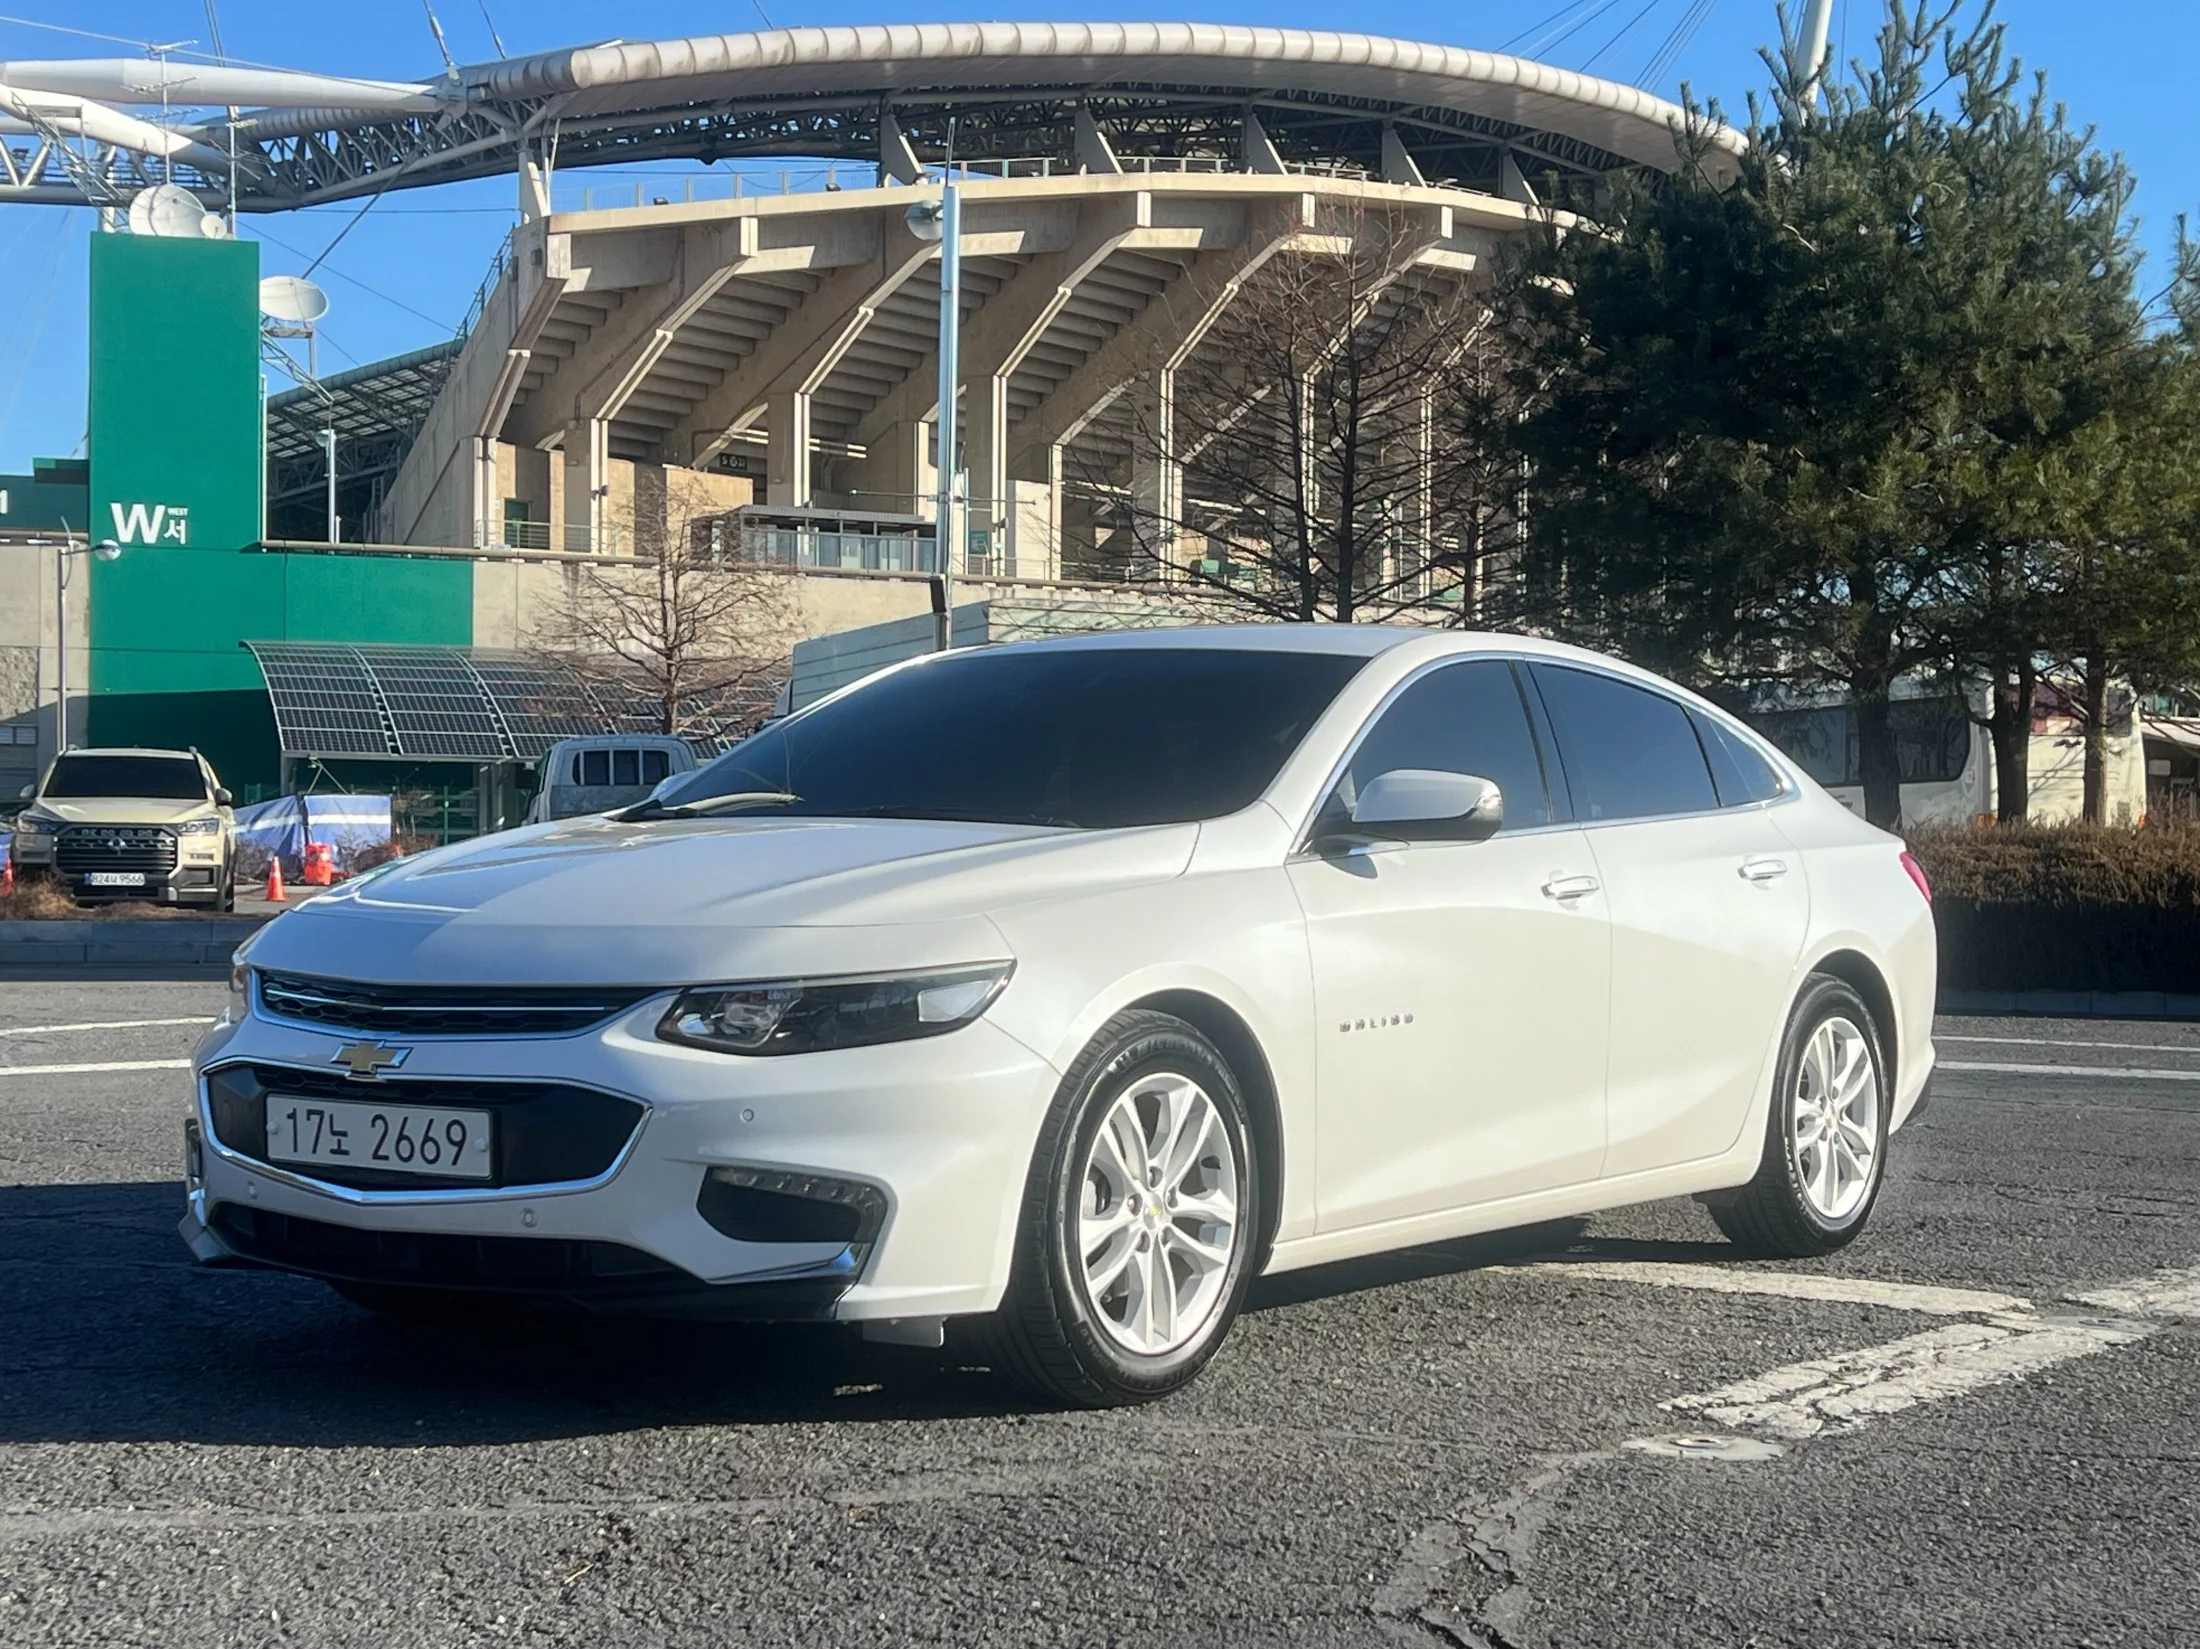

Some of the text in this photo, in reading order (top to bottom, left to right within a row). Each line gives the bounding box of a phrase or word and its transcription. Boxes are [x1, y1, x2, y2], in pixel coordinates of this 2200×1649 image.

[110, 502, 166, 544] W
[163, 519, 187, 545] 서
[286, 1107, 467, 1166] 17노 2669
